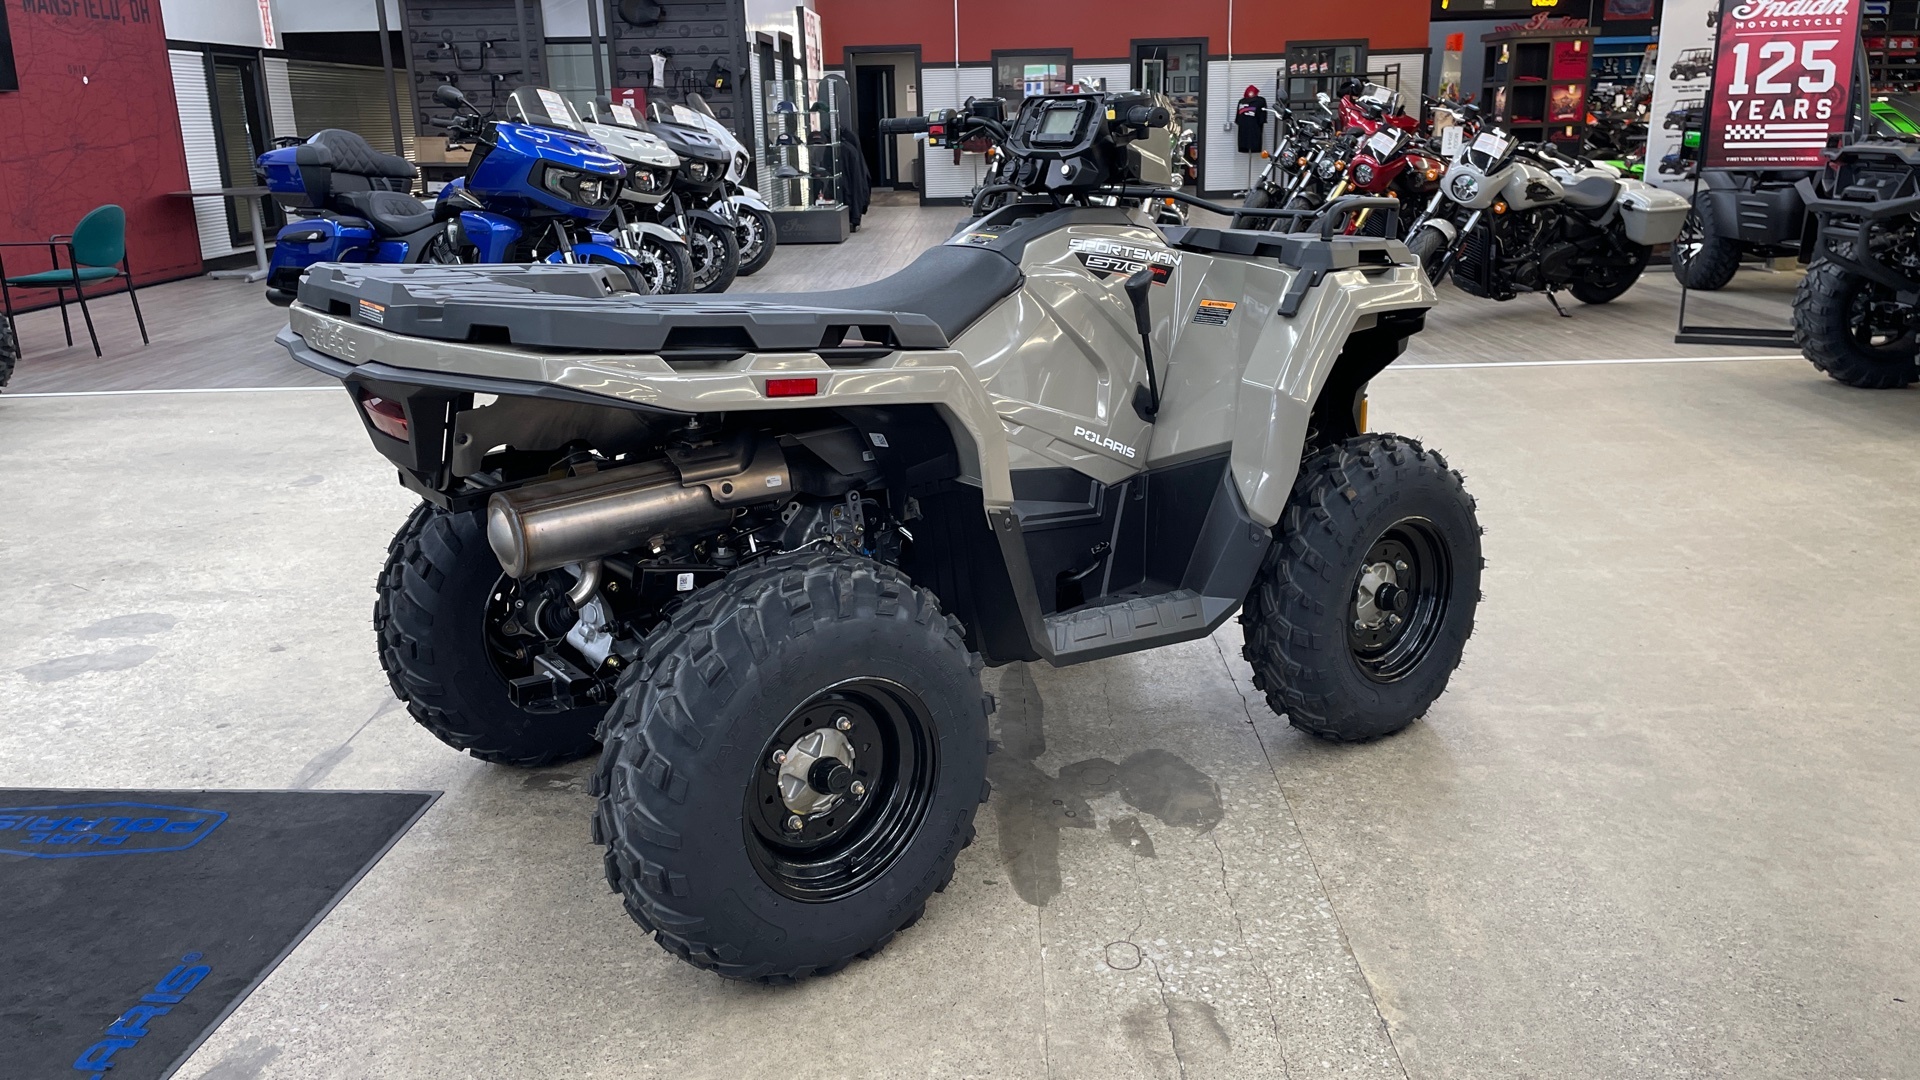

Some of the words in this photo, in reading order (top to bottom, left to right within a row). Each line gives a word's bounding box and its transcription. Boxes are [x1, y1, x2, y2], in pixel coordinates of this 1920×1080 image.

[129, 0, 151, 23] OH
[1732, 0, 1849, 20] Indian
[1735, 18, 1844, 30] MOTORCYCLE
[67, 65, 87, 75] OHIO
[1728, 39, 1839, 95] 125
[1727, 98, 1832, 121] YEARS
[1068, 238, 1183, 266] SPORTSMAN
[1085, 254, 1148, 273] 570
[1073, 425, 1136, 459] POLARIS
[0, 815, 207, 833] POLARIS
[19, 832, 131, 845] PURE
[71, 964, 212, 1080] ARIS
